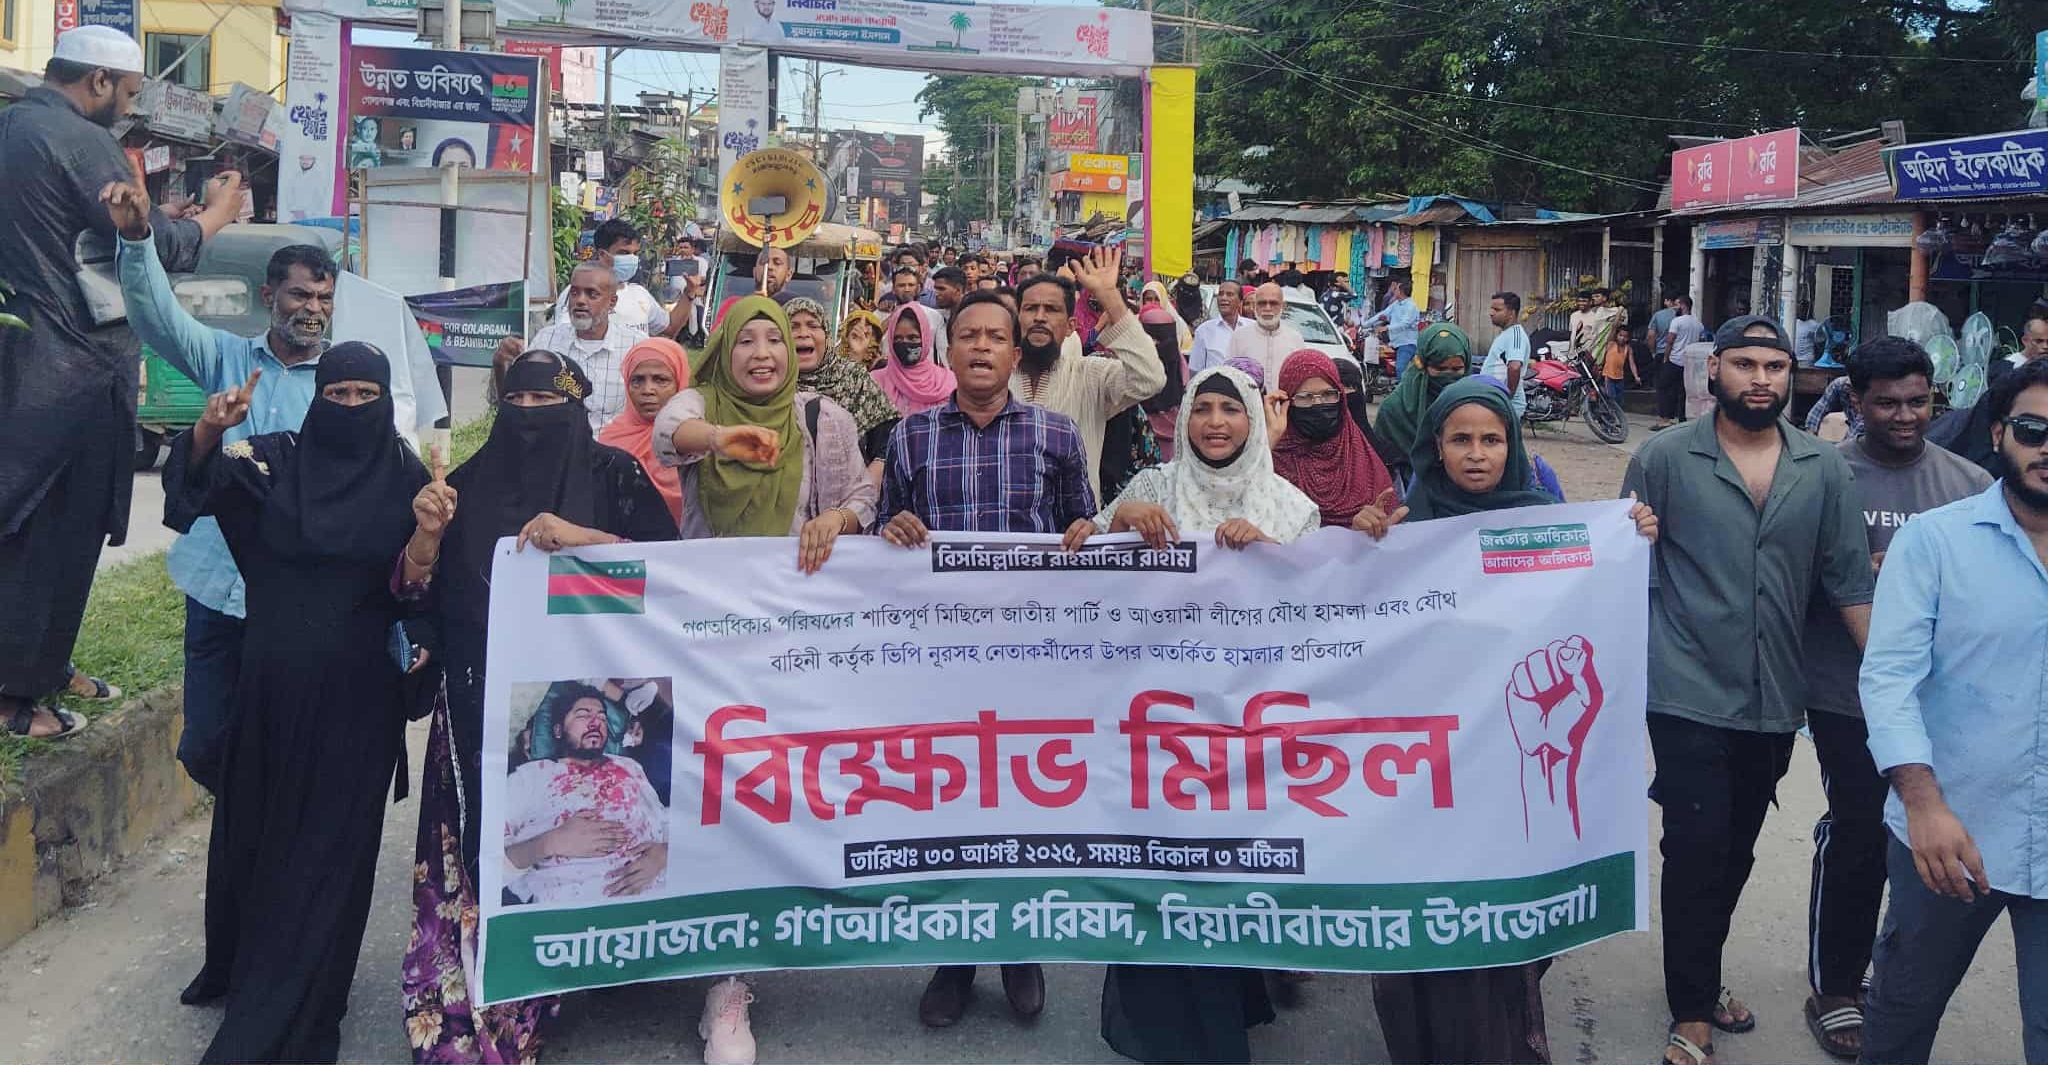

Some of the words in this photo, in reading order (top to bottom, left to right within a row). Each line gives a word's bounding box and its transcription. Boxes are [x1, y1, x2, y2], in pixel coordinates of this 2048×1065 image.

[359, 60, 410, 94] উন্নত
[414, 64, 484, 96] ভবিষ্যৎ
[1760, 140, 1777, 175] রবি
[1900, 151, 1949, 184] অহিদ
[1949, 140, 2046, 181] ইলেকট্রিক
[444, 322, 460, 333] FOR
[461, 322, 511, 335] GOLAPGANJ
[445, 335, 452, 347] &
[1480, 532, 1528, 547] জনতার
[1533, 527, 1589, 544] অধিকার
[937, 544, 1044, 571] বিসমিল্লাহির
[1483, 555, 1535, 569] আমাদের
[682, 614, 771, 640] গণঅধিকার
[777, 610, 854, 632] পরিষদের
[861, 604, 929, 633] শান্তিপূর্ণ
[934, 604, 993, 626] মিছিলে
[1001, 600, 1055, 624] জাতীয়
[1109, 608, 1121, 622] ও
[1128, 603, 1202, 629] আওয়ামী
[1210, 601, 1264, 626] লীগের
[1268, 600, 1306, 622] যৌথ
[1313, 603, 1367, 622] হামলা
[1374, 600, 1409, 618] এবং
[1416, 590, 1457, 612] যৌথ
[769, 648, 820, 674] বাহিনী
[828, 646, 875, 673] কর্তৃক
[881, 643, 921, 666] ভিপি
[928, 645, 979, 669] নূরসহ
[985, 638, 1094, 664] নেতাকর্মীদের
[1100, 639, 1141, 662] উপর
[1148, 639, 1217, 664] অতর্কিত
[1223, 644, 1283, 667] হামলার
[1290, 639, 1368, 662] প্রতিবাদে
[694, 703, 1094, 828] বিক্ষোভ
[1119, 688, 1460, 818] মিছিল
[850, 844, 918, 871] তারিখঃ
[925, 848, 955, 865] ৩০
[960, 839, 1019, 863] আগস্ট
[1025, 843, 1082, 866] ২০২৫,
[1087, 842, 1142, 866] সময়ঃ
[1146, 840, 1209, 867] বিকাল
[1215, 852, 1232, 866] ৩
[1237, 841, 1298, 869] ঘটিকা
[774, 894, 999, 946] গণঅধিকার
[1012, 889, 1148, 946] পরিষদ,
[1157, 890, 1412, 950] বিয়ানীবাজার
[1422, 883, 1598, 945] উপজেলা।
